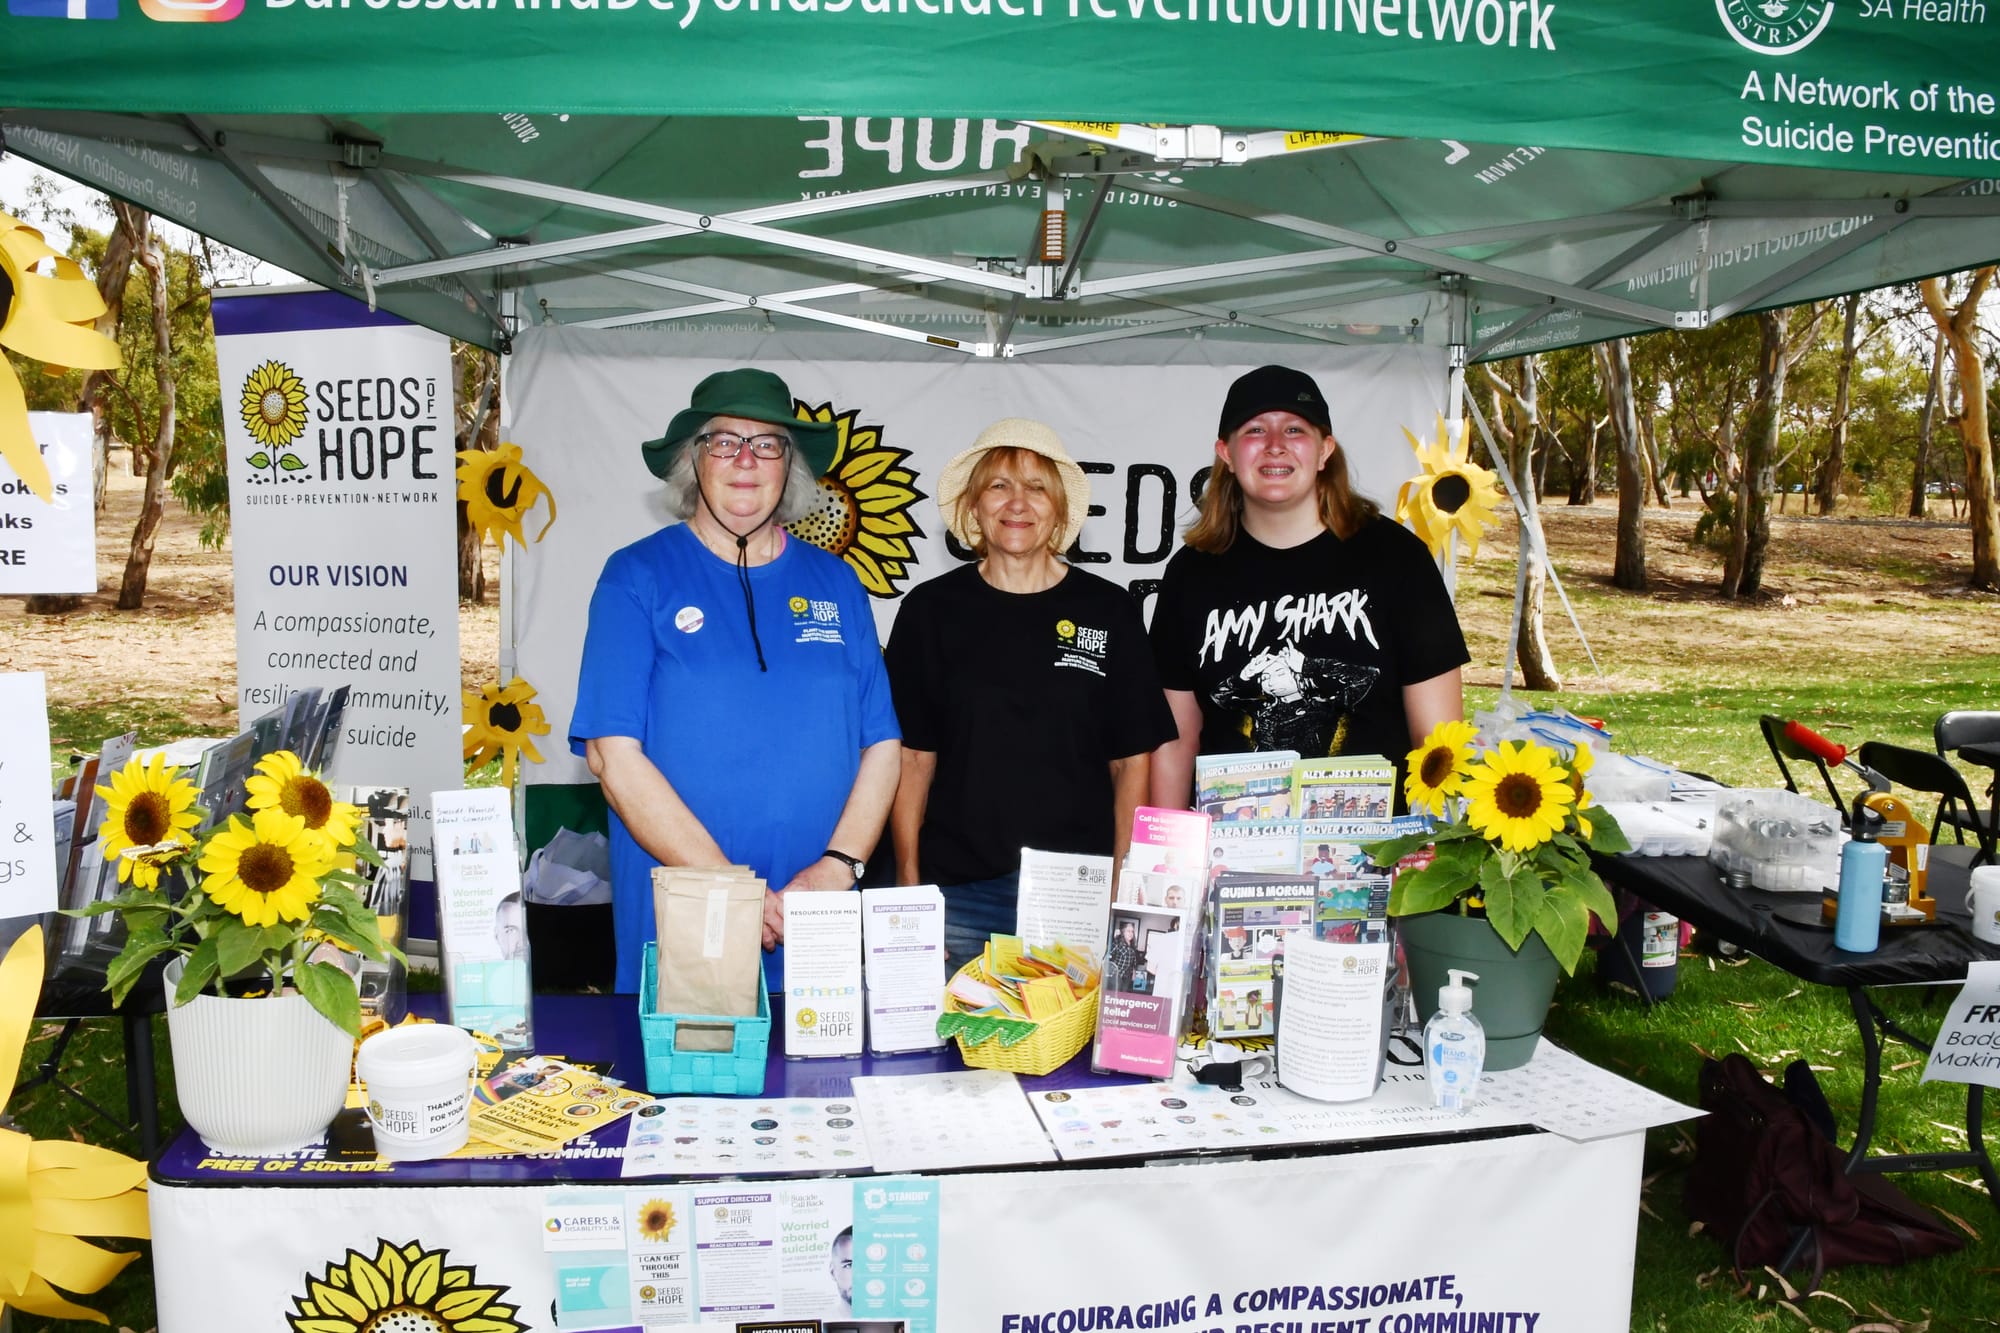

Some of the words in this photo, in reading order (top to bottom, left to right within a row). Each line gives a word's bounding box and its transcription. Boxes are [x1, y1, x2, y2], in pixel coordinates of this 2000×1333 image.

[1740, 71, 1765, 100] A
[1774, 73, 1900, 110] Network
[1910, 84, 1939, 112] of
[1948, 85, 1996, 115] the
[1290, 131, 1317, 144] LIFT
[1741, 116, 1854, 152] Suicide
[315, 377, 420, 422] SEEDS
[318, 425, 438, 481] HOPE
[246, 495, 288, 505] SUICIDE
[297, 493, 369, 504] PREVENTION
[377, 492, 438, 503] NETWORK
[269, 565, 320, 587] OUR
[327, 565, 408, 587] VISION
[813, 609, 841, 623] HOPE
[253, 610, 267, 631] A
[274, 612, 436, 638] compassionate,
[1199, 600, 1267, 668] AMY
[1273, 588, 1380, 650] SHARK
[1077, 636, 1107, 654] HOPE
[268, 648, 373, 670] connected
[378, 650, 418, 672] and
[346, 725, 417, 748] suicide
[1360, 768, 1393, 778] SACHA
[1209, 828, 1250, 839] SARAH
[1263, 825, 1300, 837] CLARE
[1303, 825, 1341, 835] OLIVER
[1350, 823, 1396, 835] CONNOR
[1088, 875, 1107, 885] HOPE
[1220, 886, 1256, 899] QUINN
[1256, 887, 1264, 897] &
[1265, 884, 1315, 897] MORGAN
[901, 923, 920, 931] HOPE
[1358, 958, 1379, 966] SEEDS
[1357, 966, 1379, 975] HOPE
[1104, 994, 1159, 1011] Emergency
[819, 1011, 850, 1023] SEEDS
[1103, 1006, 1130, 1018] Relief
[819, 1022, 853, 1037] HOPE
[1119, 1020, 1143, 1029] services
[1143, 1022, 1157, 1030] and
[427, 1100, 453, 1111] THANK
[518, 1096, 544, 1107] HOW
[545, 1105, 557, 1113] TO
[1369, 1104, 1423, 1116] South
[384, 1109, 414, 1121] SEEDS
[430, 1113, 446, 1122] FOR
[508, 1101, 527, 1111] ASK
[527, 1106, 555, 1120] YOUR
[557, 1116, 580, 1128] MOB
[508, 1108, 536, 1122] YOUR
[385, 1120, 418, 1134] HOPE
[1292, 1116, 1393, 1132] Prevention
[197, 1158, 260, 1173] FREE
[263, 1158, 297, 1173] OF
[299, 1159, 396, 1173] SUICIDE.
[697, 1196, 729, 1205] SUPPORT
[730, 1195, 769, 1203] DIRECTORY
[888, 1191, 930, 1201] STANDBY
[564, 1217, 608, 1226] CARERS
[612, 1216, 620, 1224] &
[730, 1215, 753, 1224] HOPE
[781, 1219, 830, 1232] Worried
[782, 1233, 818, 1243] about
[782, 1242, 830, 1254] suicide?
[663, 1254, 680, 1262] GET
[640, 1263, 680, 1271] THROUGH
[658, 1287, 680, 1296] SEEDS
[658, 1295, 684, 1305] HOPE
[1001, 1295, 1197, 1333] ENCOURAGING
[1204, 1293, 1223, 1317] A
[1233, 1274, 1464, 1314] COMPASSIONATE,
[1378, 1311, 1541, 1333] COMMUNITY
